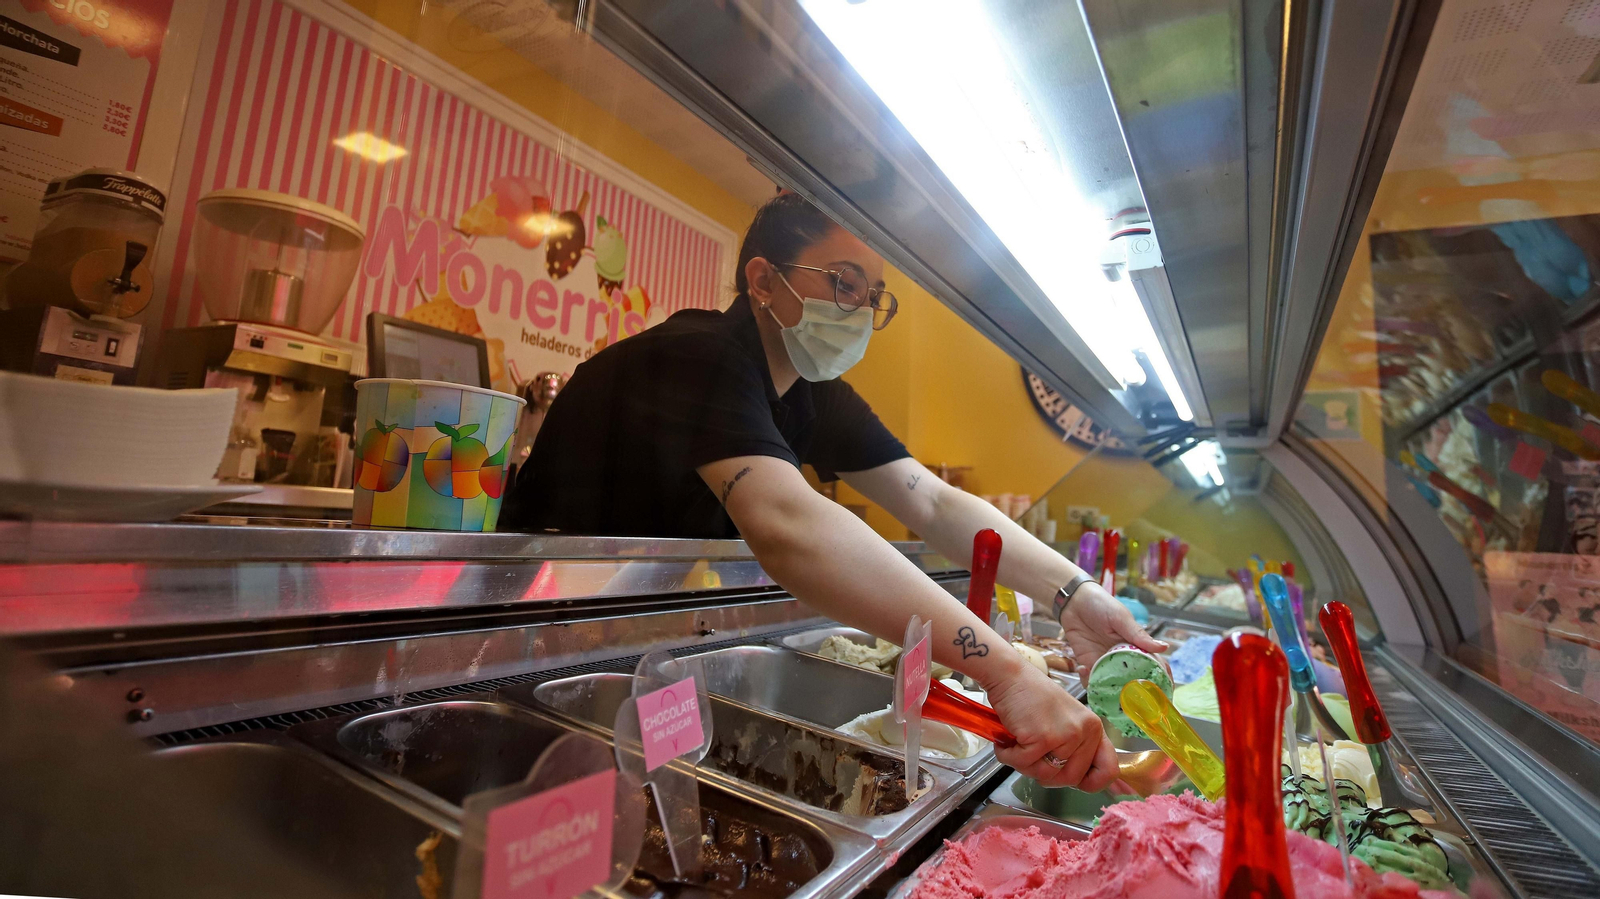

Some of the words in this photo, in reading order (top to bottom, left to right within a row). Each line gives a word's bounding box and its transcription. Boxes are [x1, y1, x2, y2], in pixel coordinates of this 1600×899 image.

[521, 328, 581, 358] heladeros
[643, 697, 696, 732] CHOCOLATE
[652, 729, 665, 743] SIN
